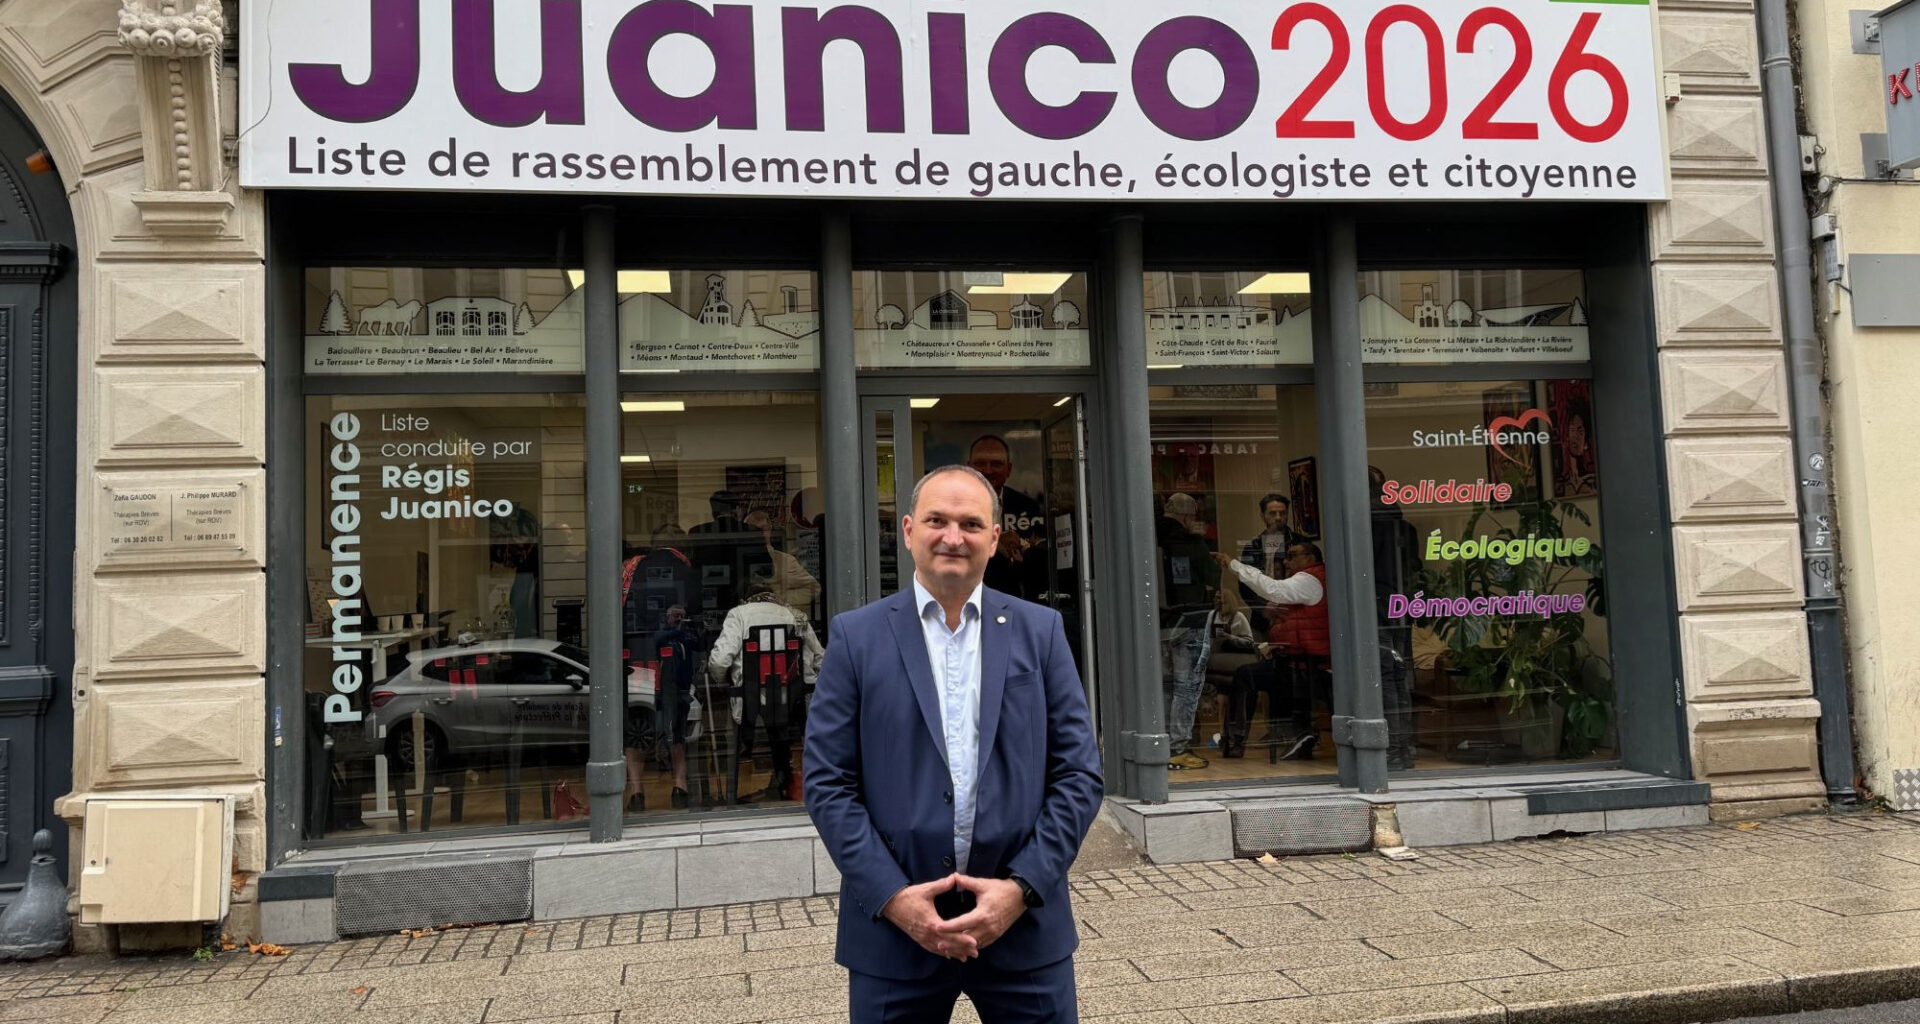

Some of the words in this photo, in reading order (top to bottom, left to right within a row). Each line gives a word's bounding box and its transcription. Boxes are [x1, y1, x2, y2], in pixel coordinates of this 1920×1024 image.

[288, 0, 1259, 141] Juanico
[1271, 2, 1629, 143] 2026
[1888, 61, 1920, 105] K
[288, 137, 406, 176] Liste
[428, 138, 490, 177] de
[512, 144, 878, 184] rassemblement
[895, 148, 950, 185] de
[968, 150, 1136, 197] gauche,
[1155, 152, 1371, 198] écologiste
[1388, 158, 1429, 187] et
[1444, 154, 1637, 197] citoyenne
[327, 347, 372, 355] Badouillère
[381, 347, 420, 355] Beaubrun
[636, 343, 666, 352] Bergson
[1367, 337, 1398, 345] Jomayère
[1456, 336, 1479, 344] Métare
[1494, 336, 1536, 344] Richelandière
[1369, 346, 1386, 355] Tardy
[314, 358, 325, 366] La
[326, 358, 359, 366] Terrasse
[365, 358, 376, 366] Le
[377, 358, 405, 367] Bernay
[425, 357, 452, 365] Marais
[461, 357, 471, 365] Le
[502, 357, 553, 365] Marandinière
[636, 353, 662, 361] Méons
[763, 352, 797, 360] Monthieu
[1160, 349, 1205, 357] Saint-François
[381, 413, 430, 431] Liste
[1412, 425, 1550, 447] Saint-Étienne
[381, 438, 486, 457] conduite
[493, 441, 532, 459] par
[381, 462, 470, 494] Régis
[186, 492, 210, 500] Philippe
[1381, 478, 1513, 505] Solidaire
[380, 495, 513, 520] Juanico
[1425, 528, 1591, 565] Écologique
[323, 411, 363, 723] Permanence
[1388, 590, 1585, 618] Démocratique
